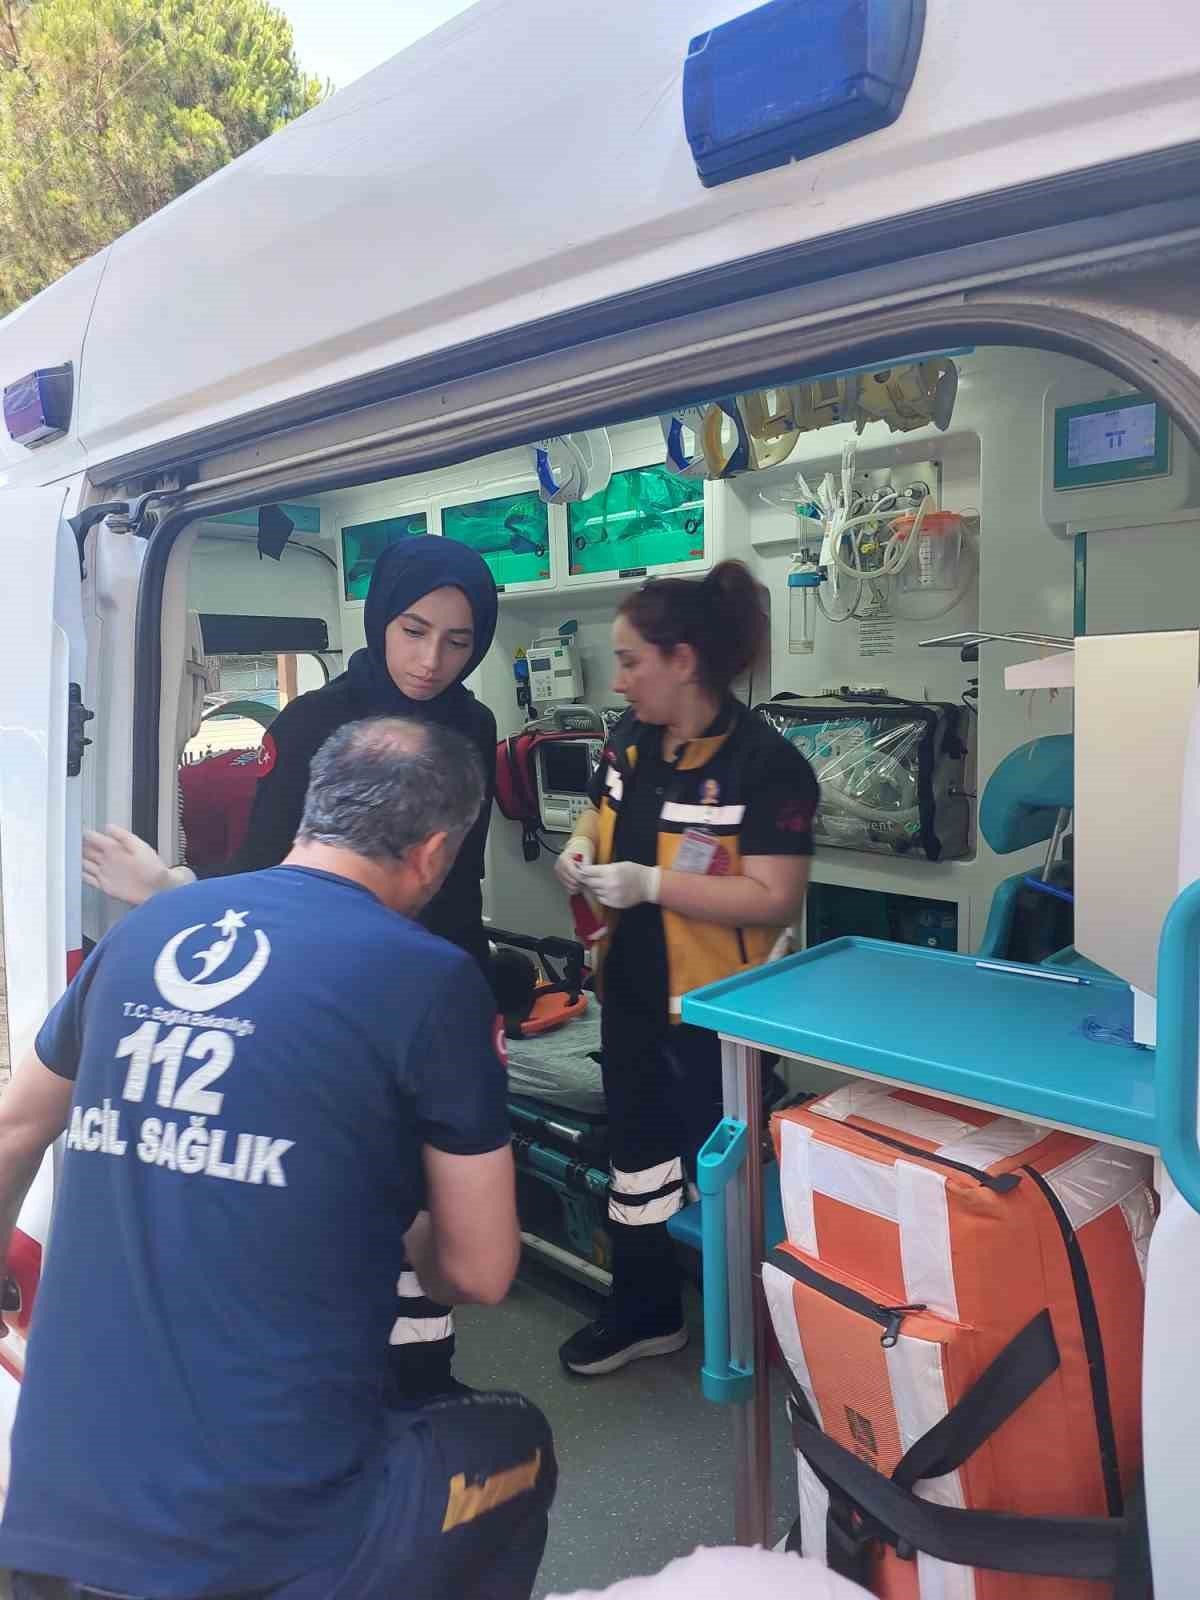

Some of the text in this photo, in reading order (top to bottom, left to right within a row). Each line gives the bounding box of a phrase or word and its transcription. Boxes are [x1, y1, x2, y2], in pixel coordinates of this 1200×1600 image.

[115, 1020, 236, 1116] 112
[66, 1098, 296, 1188] ACİL SAĞLIK
